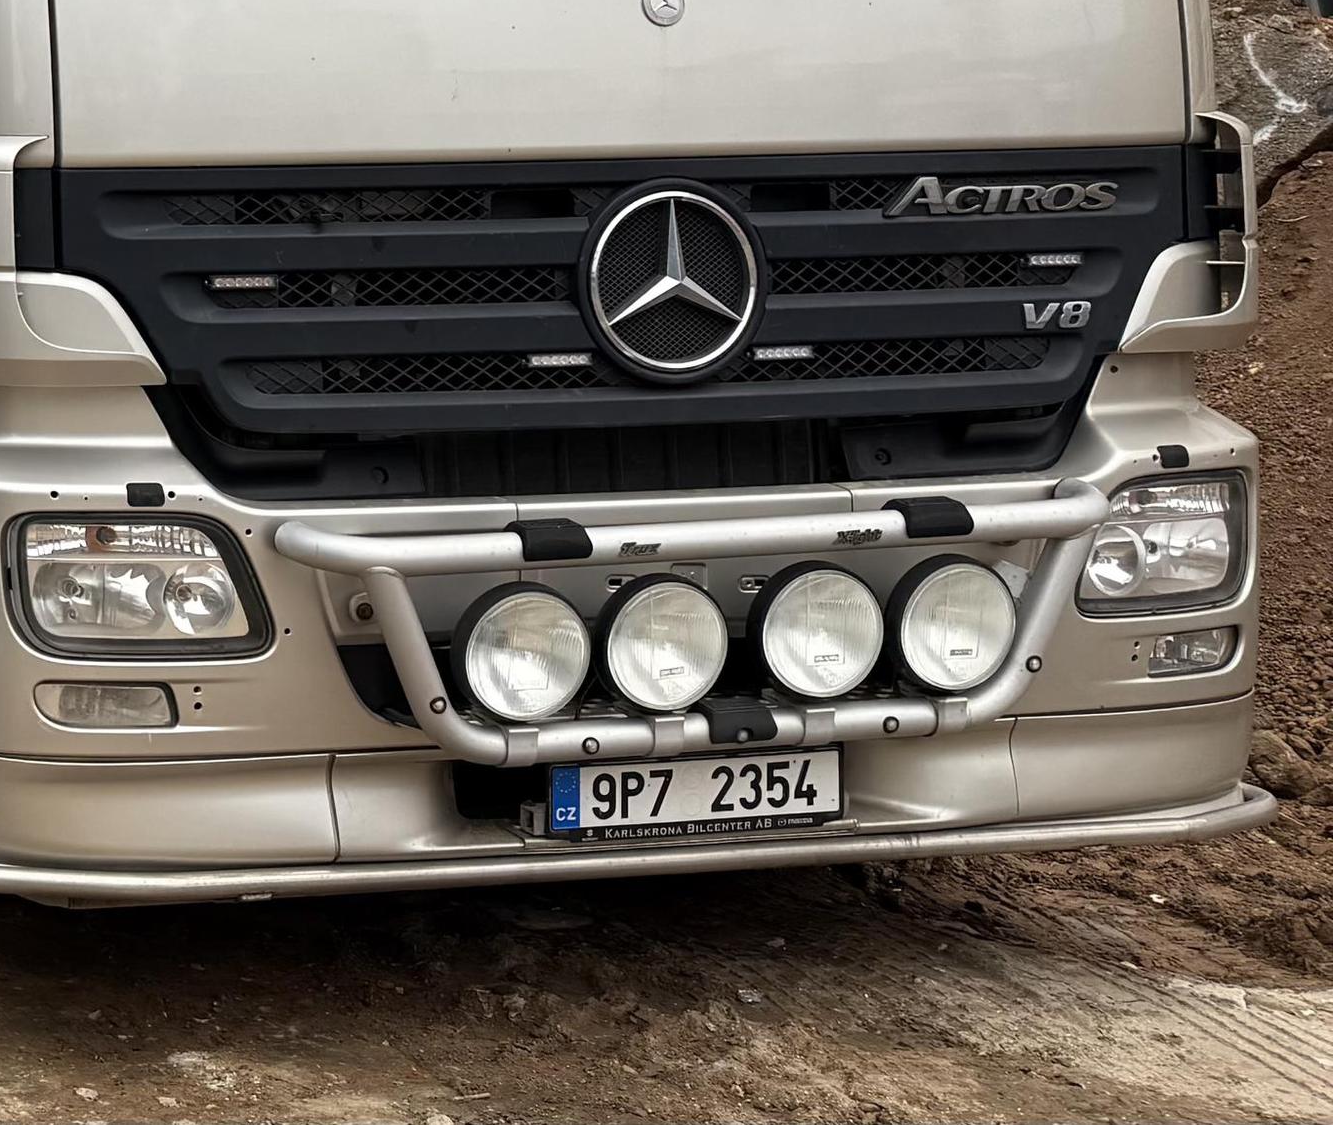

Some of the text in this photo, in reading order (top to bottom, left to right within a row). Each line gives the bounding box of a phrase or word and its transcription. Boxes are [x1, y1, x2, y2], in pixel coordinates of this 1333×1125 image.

[1022, 300, 1092, 330] V8
[592, 759, 817, 820] 9P7 2354
[555, 806, 577, 821] CZ
[605, 825, 683, 839] KARLSKRONA
[687, 821, 751, 834] BILCENTER
[755, 818, 772, 829] AB
